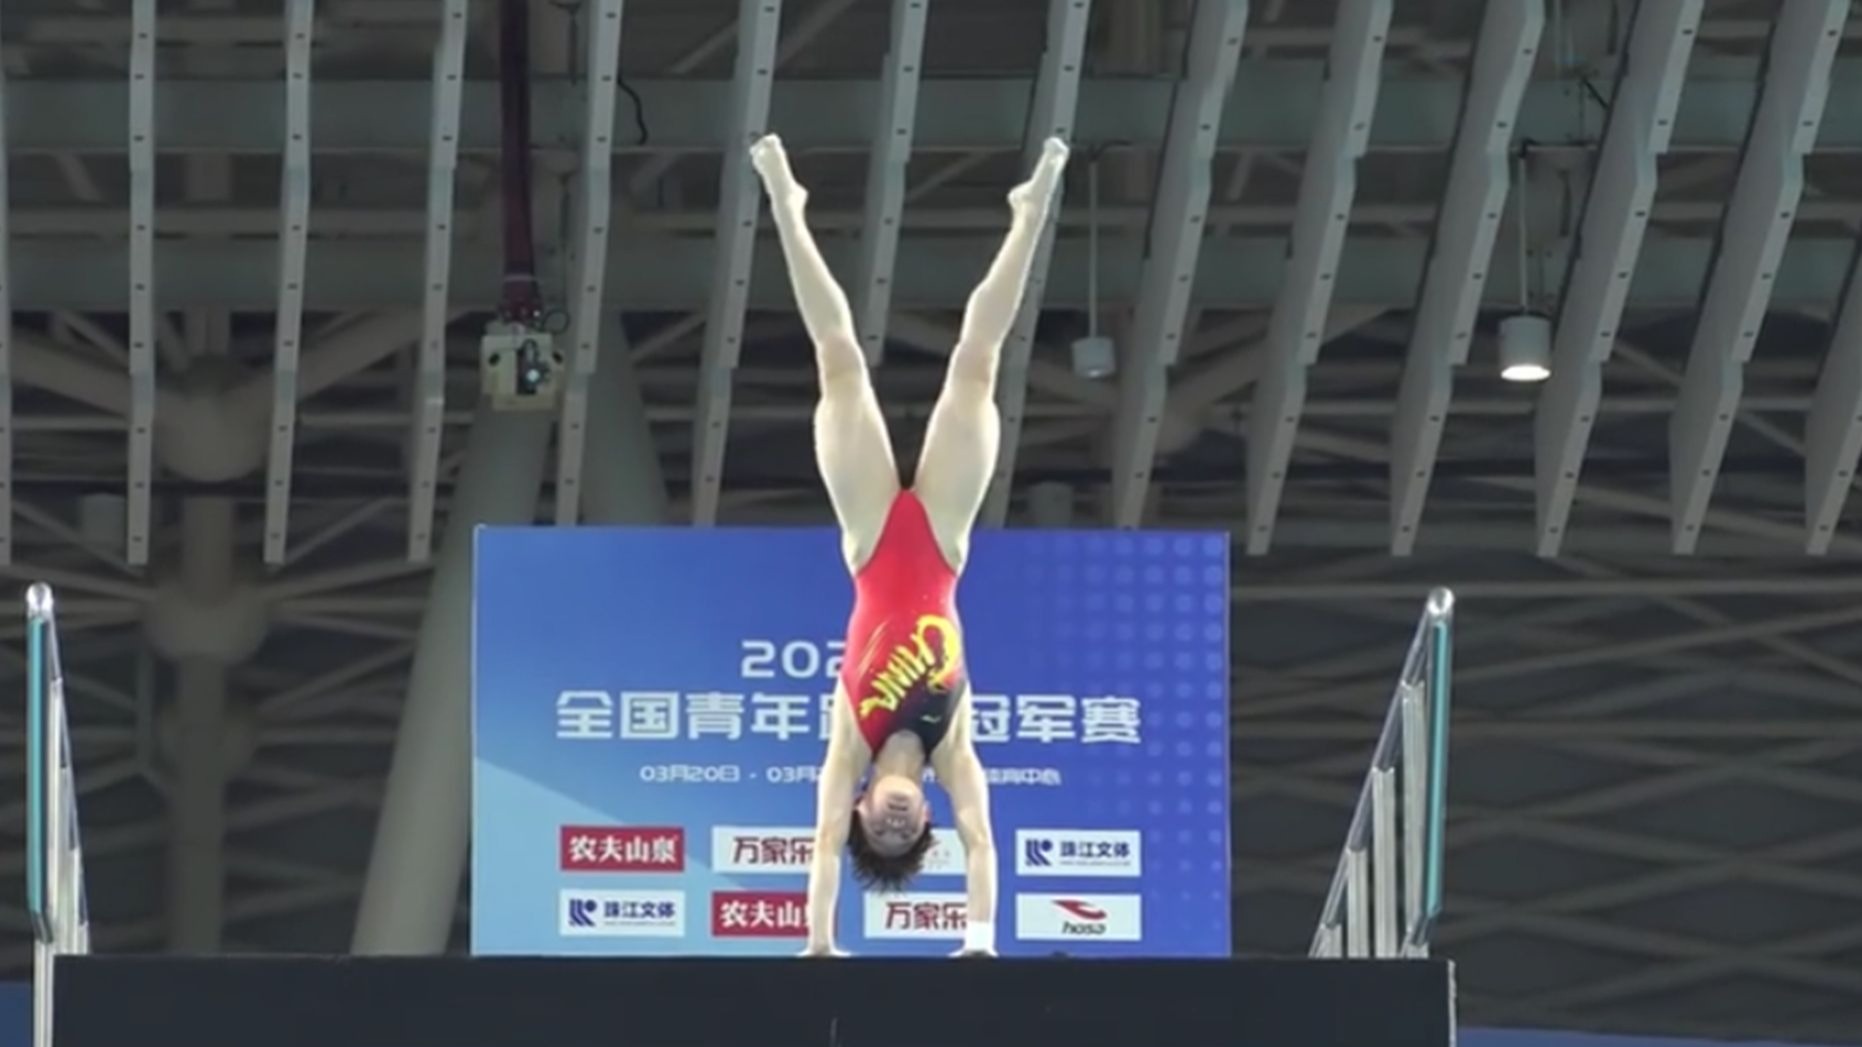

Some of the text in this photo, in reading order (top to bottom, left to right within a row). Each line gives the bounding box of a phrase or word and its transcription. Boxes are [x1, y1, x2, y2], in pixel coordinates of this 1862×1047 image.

[859, 613, 961, 719] CHINA
[765, 764, 822, 784] 03月
[569, 835, 678, 864] 农夫山泉
[732, 836, 815, 865] 万家乐
[720, 899, 808, 929] 农夫山
[885, 901, 967, 931] 万家乐
